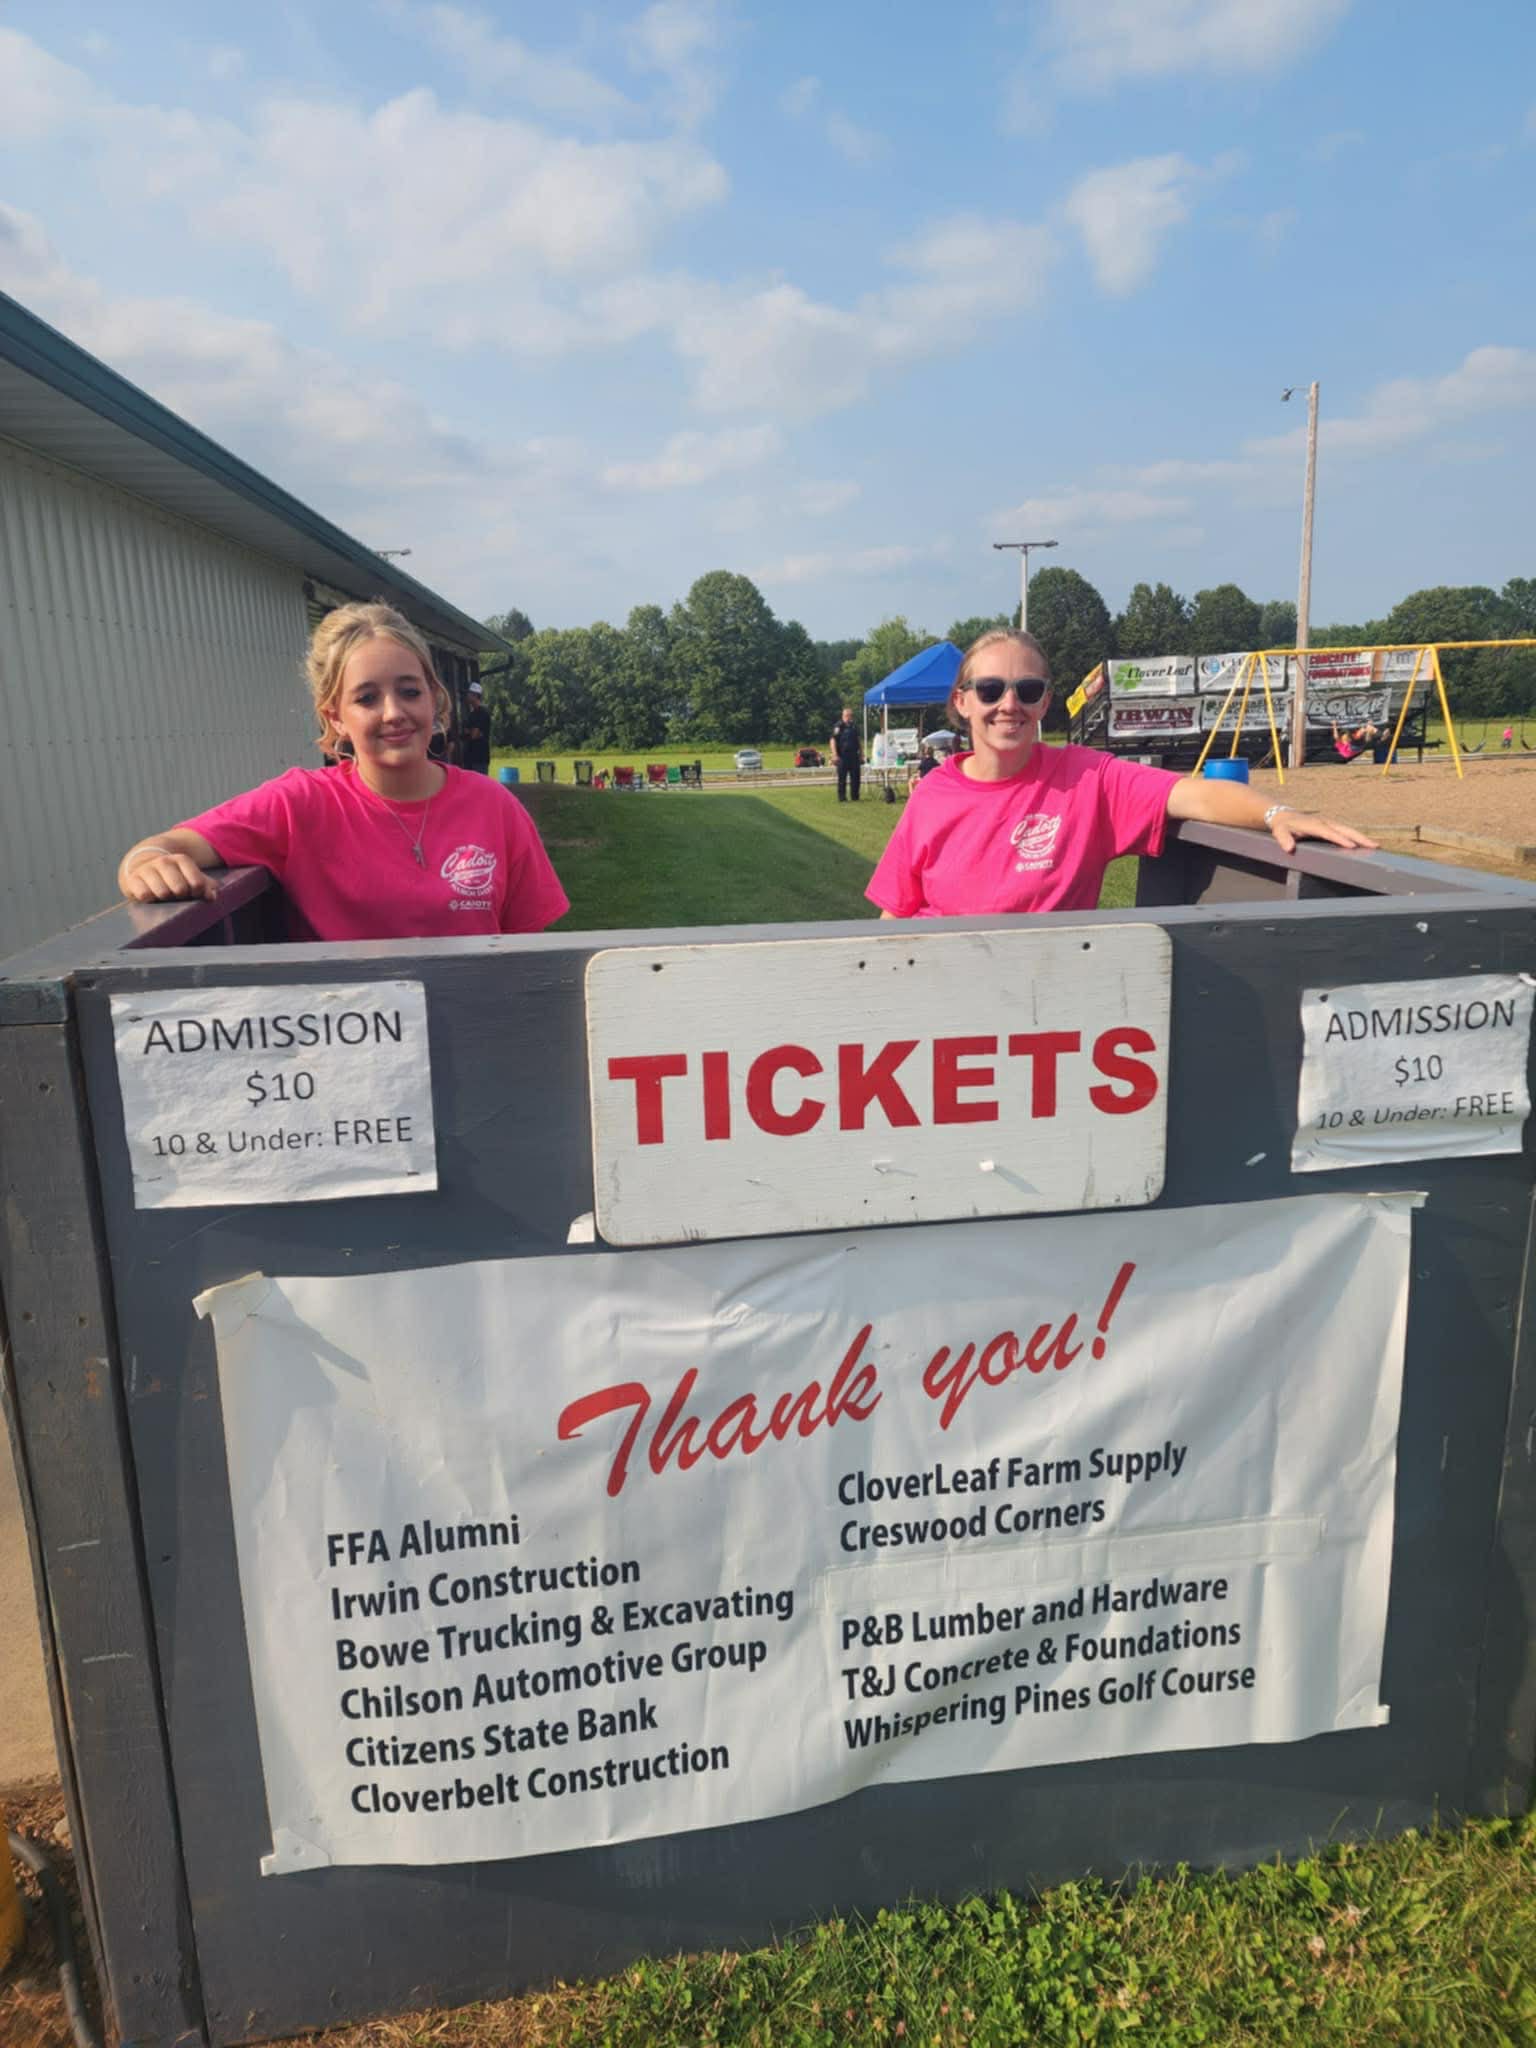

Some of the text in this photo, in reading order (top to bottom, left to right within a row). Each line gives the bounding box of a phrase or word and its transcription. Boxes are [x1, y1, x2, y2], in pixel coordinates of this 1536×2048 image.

[143, 1010, 402, 1055] ADMISSION
[1325, 999, 1515, 1043] ADMISSION
[246, 1070, 314, 1107] $10
[607, 1026, 1159, 1146] TICKETS
[1394, 1054, 1443, 1087] $10
[152, 1116, 413, 1157] 10 & Under: FREE
[1316, 1091, 1514, 1130] 10 & Under: FREE
[557, 1261, 1137, 1497] Thank you!
[838, 1441, 1188, 1506] CloverLeaf Farm Supply
[327, 1515, 521, 1567] FFA Alumni
[840, 1499, 1106, 1552] Creswood Corners
[331, 1556, 641, 1620] Irwin Construction
[842, 1577, 1229, 1650] P&B Lumber and Hardware
[336, 1586, 795, 1671] Bowe Trucking & Excavating
[842, 1620, 1241, 1700] T&J Concrete & Foundations
[340, 1639, 767, 1720] Chilson Automotive Group
[844, 1665, 1257, 1749] Whispering Pines Golf Course
[345, 1697, 659, 1768] Citizens State Bank
[351, 1741, 730, 1814] Cloverbelt Construction
